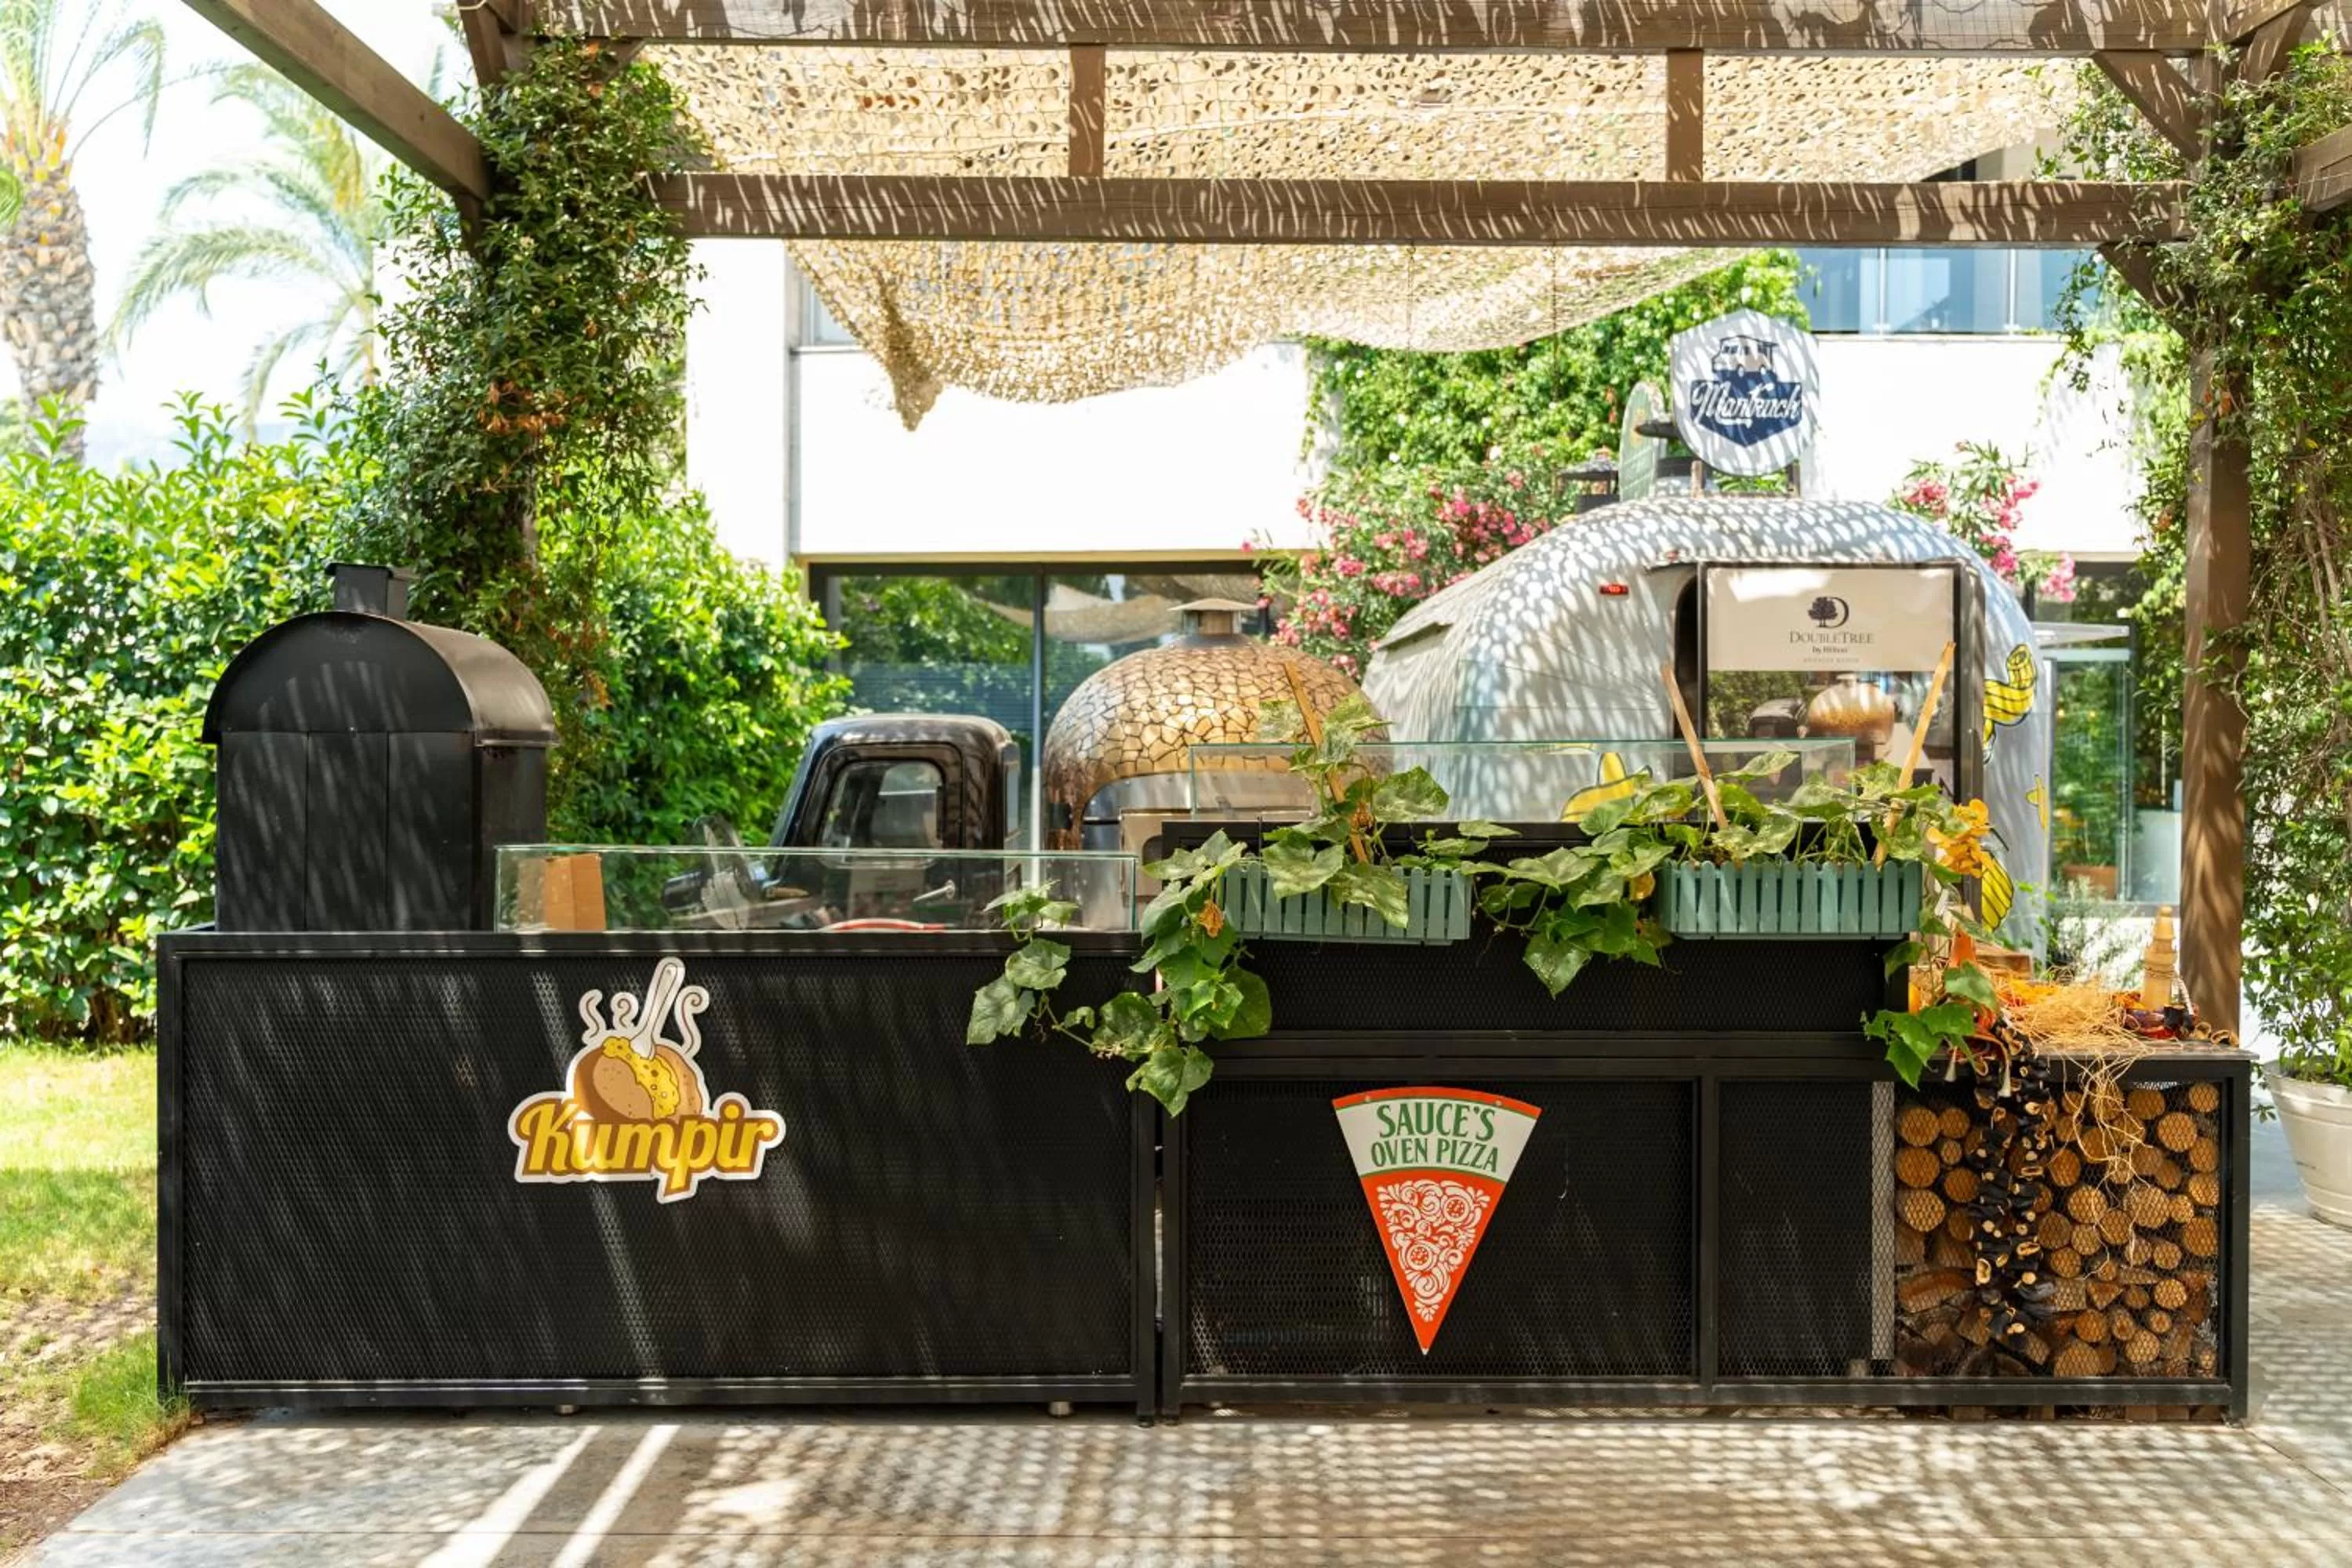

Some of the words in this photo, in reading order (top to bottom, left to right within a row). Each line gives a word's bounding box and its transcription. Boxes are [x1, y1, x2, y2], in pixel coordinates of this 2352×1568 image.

[1376, 1102, 1496, 1142] SAUCE'S
[514, 1098, 779, 1196] Kumpir
[1370, 1138, 1428, 1167] OVEN
[1436, 1138, 1499, 1173] PIZZA
